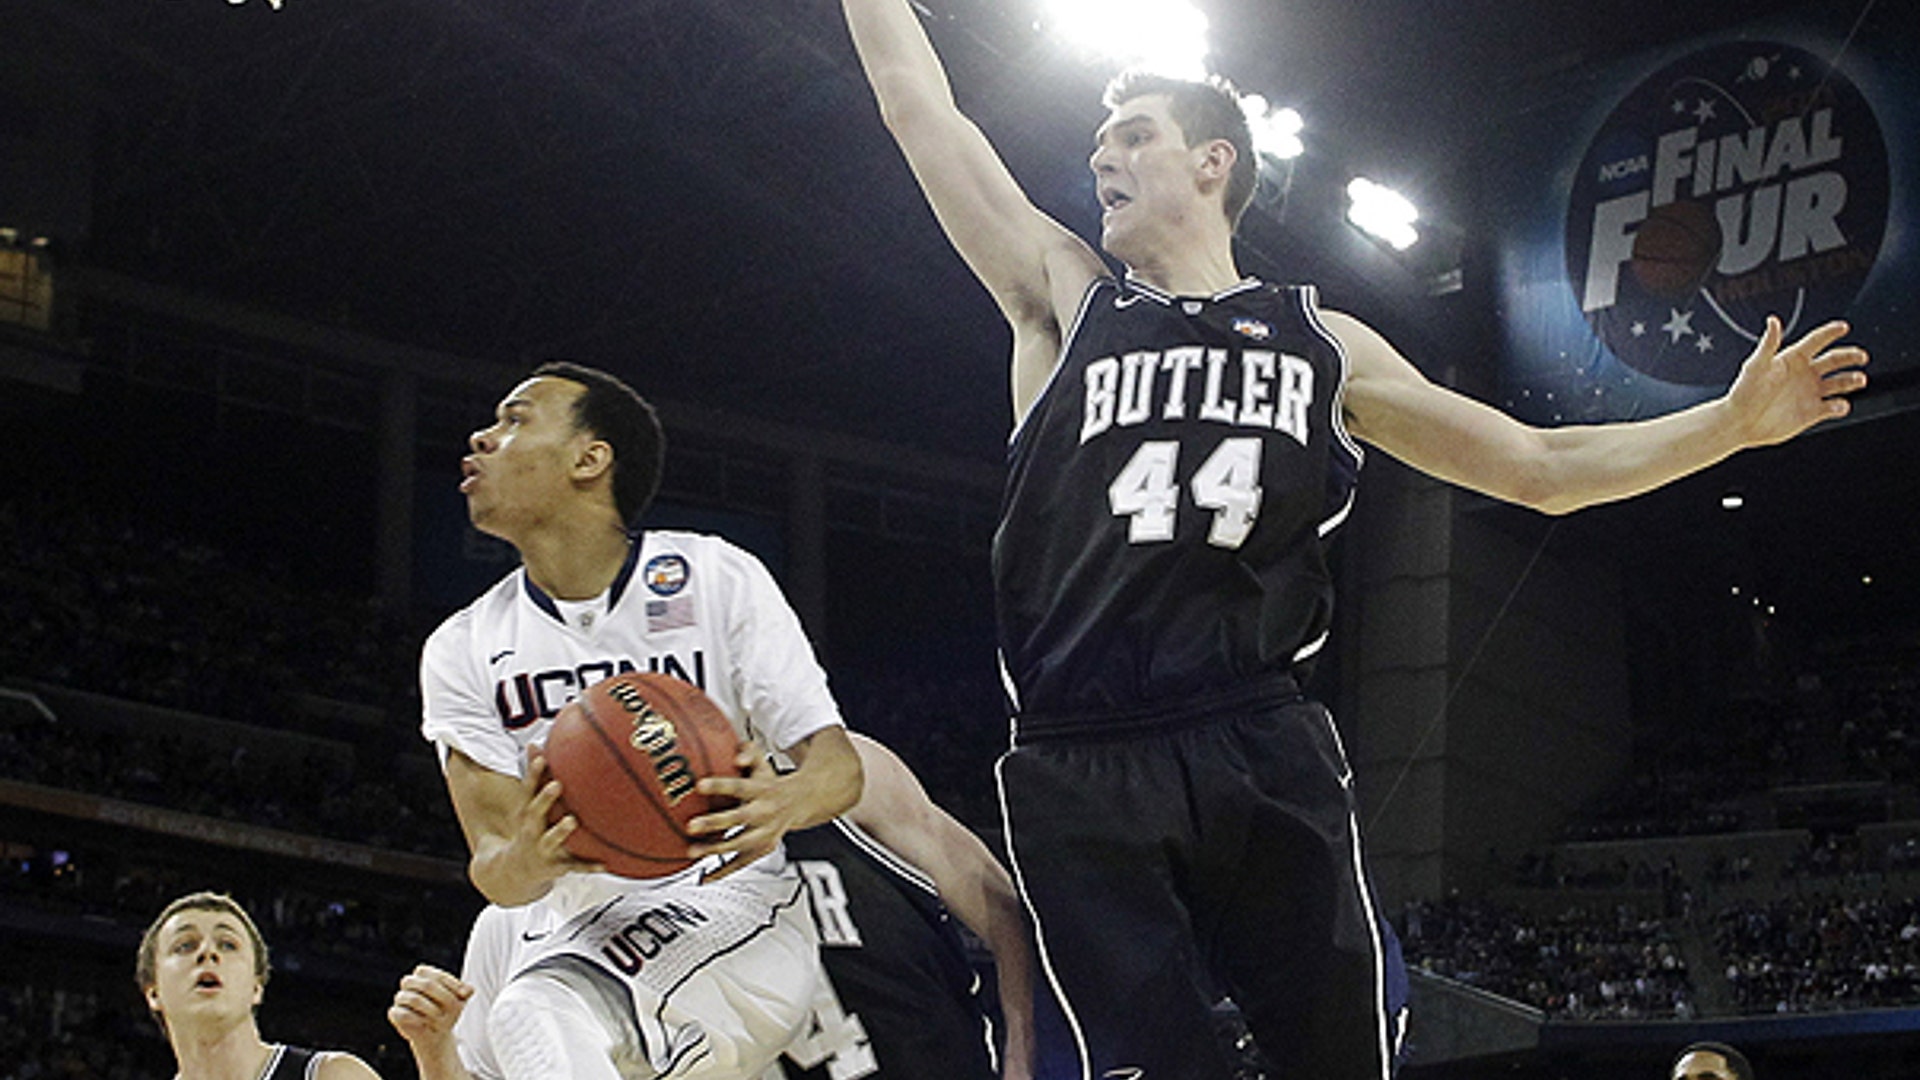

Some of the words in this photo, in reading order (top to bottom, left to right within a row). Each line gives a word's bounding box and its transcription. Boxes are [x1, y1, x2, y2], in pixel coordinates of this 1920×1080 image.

[1599, 155, 1648, 182] NCAA
[1652, 107, 1842, 207] FINAL
[1080, 346, 1314, 446] BUTLER
[1108, 437, 1263, 549] 44
